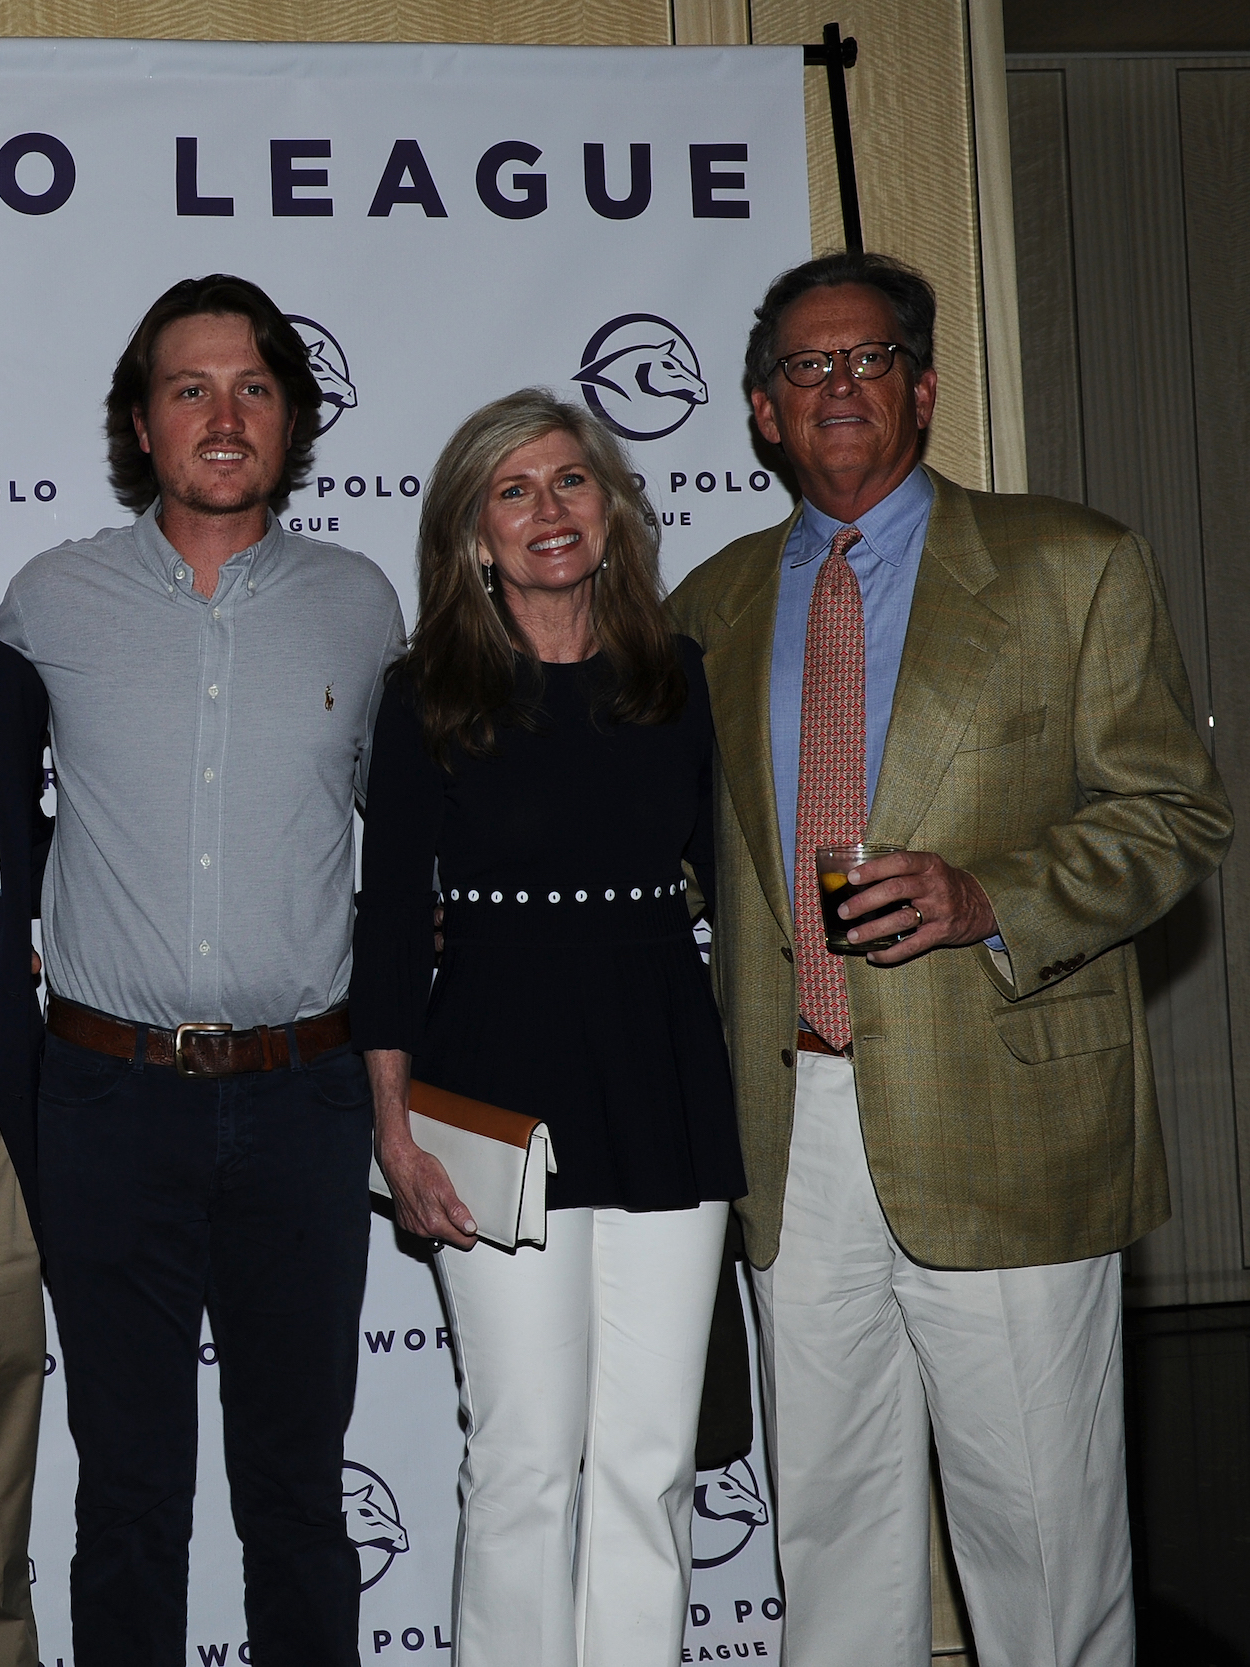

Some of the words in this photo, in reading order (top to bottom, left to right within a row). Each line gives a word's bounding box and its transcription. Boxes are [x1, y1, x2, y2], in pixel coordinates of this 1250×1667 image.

[176, 137, 751, 221] LEAGUE
[317, 475, 421, 498] POLO
[670, 470, 771, 493] POLO
[364, 1327, 453, 1354] WOR
[734, 1597, 784, 1623] PO
[373, 1625, 452, 1654] POL
[681, 1641, 768, 1663] EAGUE
